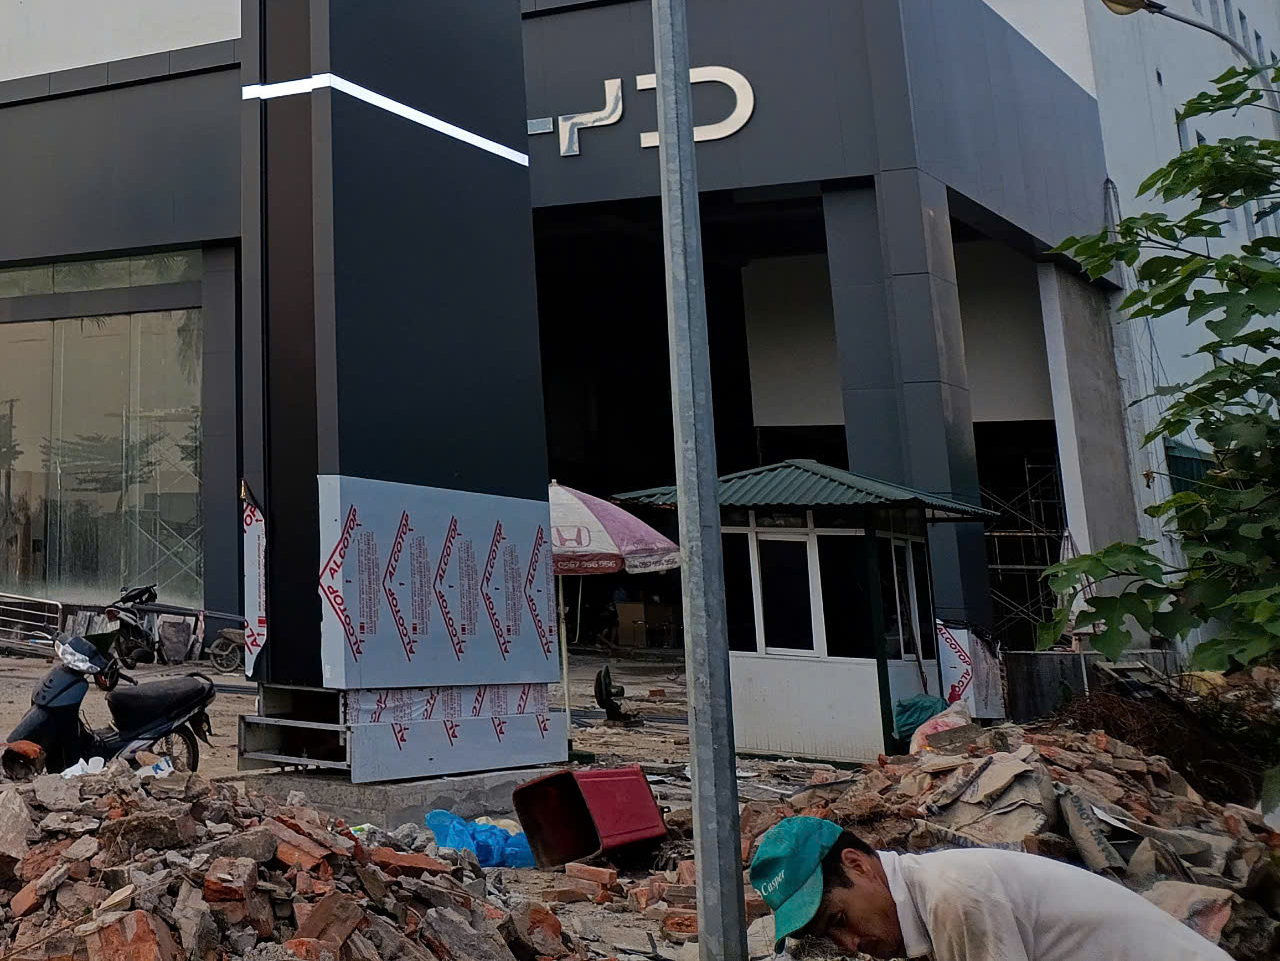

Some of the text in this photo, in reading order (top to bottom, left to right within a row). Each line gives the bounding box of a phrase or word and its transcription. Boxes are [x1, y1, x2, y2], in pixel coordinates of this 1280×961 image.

[527, 66, 754, 156] YD
[327, 508, 357, 580] ALCOTOP
[388, 514, 409, 583] ALCOTOP
[438, 518, 458, 586] ALCOTOP
[485, 523, 502, 588] ALCOTOP
[527, 526, 544, 589] ALCOTOP
[327, 585, 363, 655] ALCOTOP
[387, 588, 416, 655] ALCOTOP
[438, 590, 464, 654] ALCOTOP
[484, 592, 510, 654] ALCOTOP
[528, 594, 552, 654] ALCOTOP
[937, 627, 971, 666] ALCOTOP
[761, 869, 785, 896] Casper
